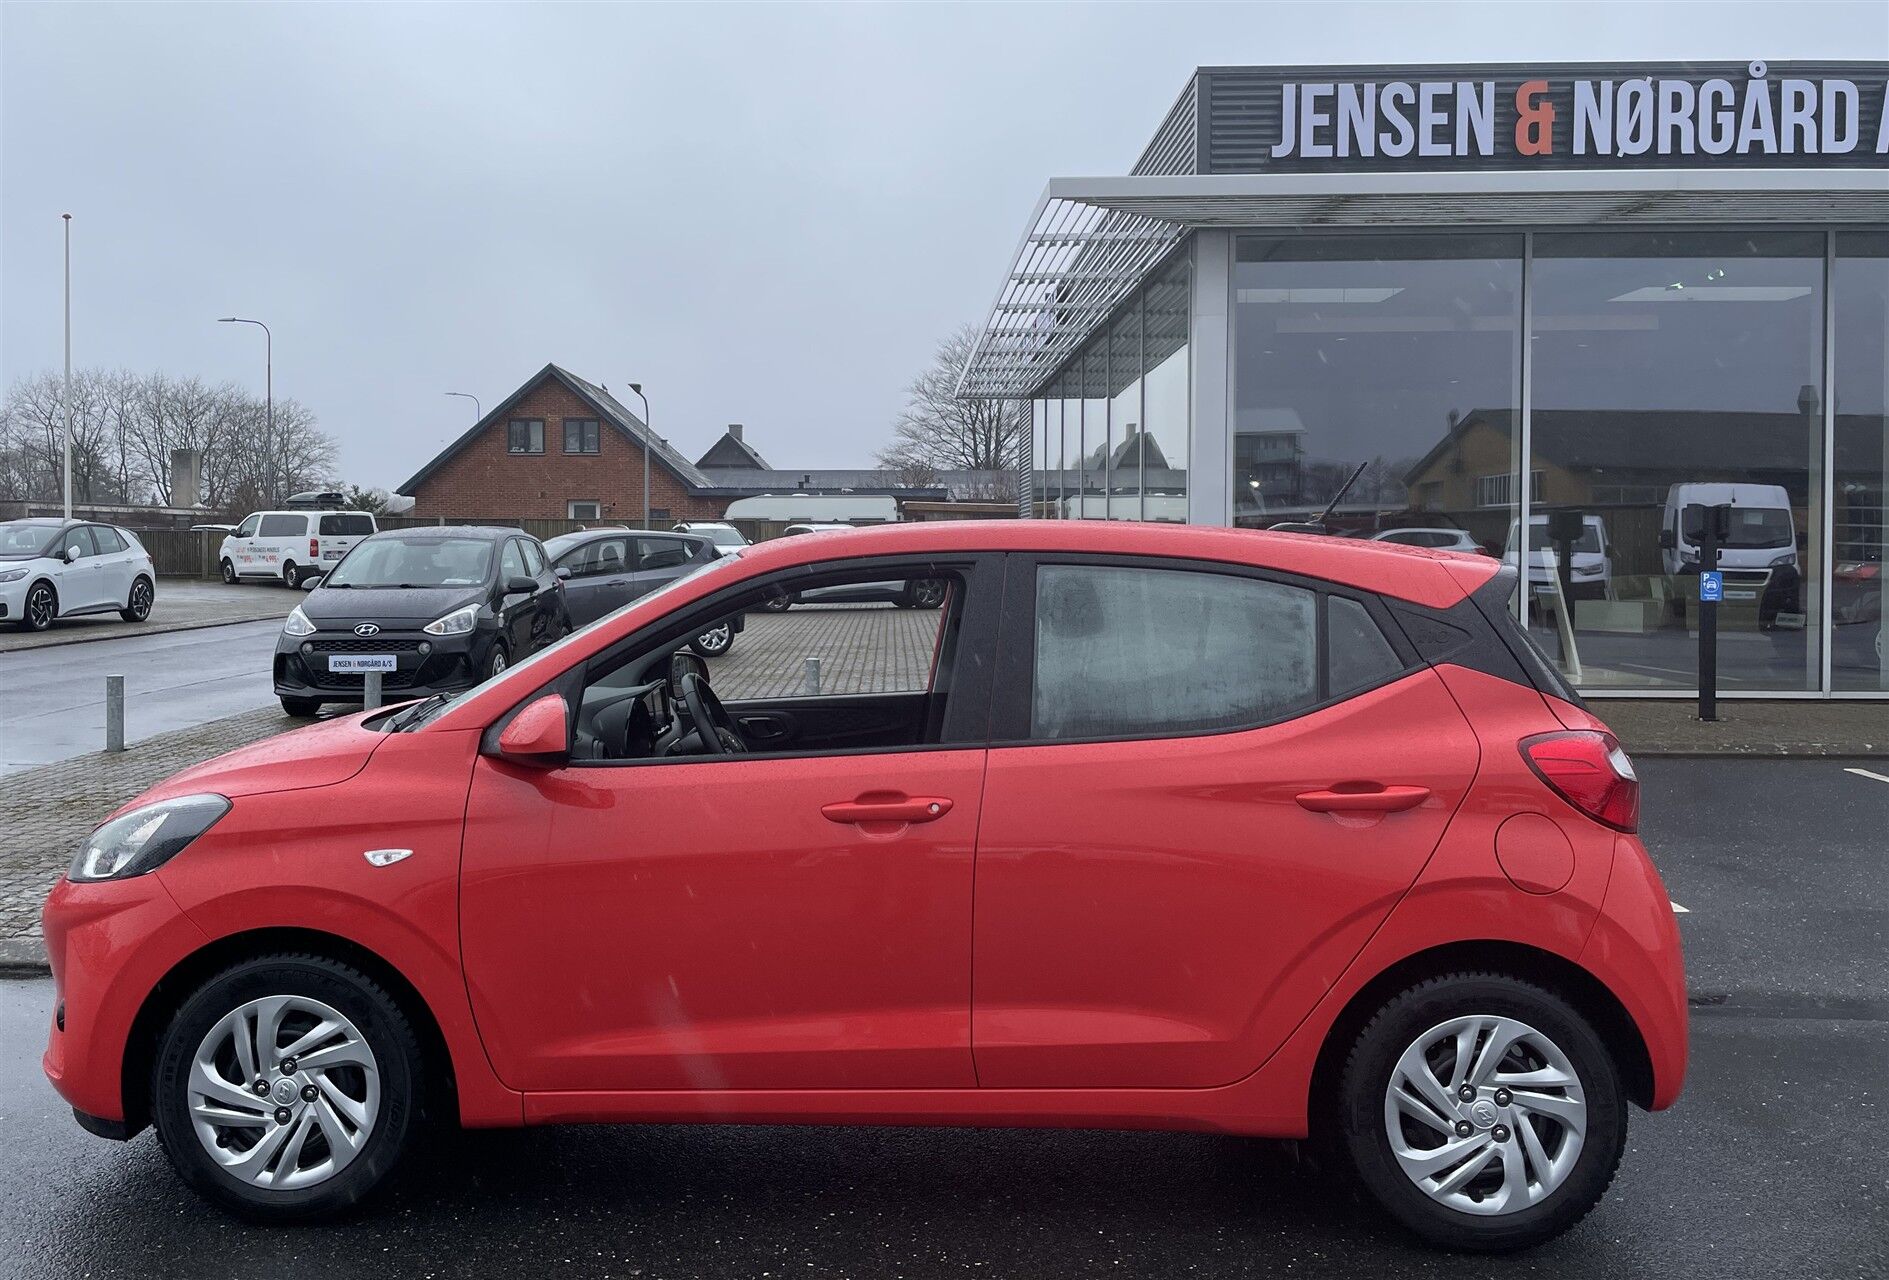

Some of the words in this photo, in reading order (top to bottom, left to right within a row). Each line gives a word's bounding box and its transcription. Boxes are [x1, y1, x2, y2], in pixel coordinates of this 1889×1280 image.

[1271, 81, 1495, 158] JENSEN
[1515, 80, 1556, 156] &
[1573, 59, 1859, 158] NØRGÅRD
[1703, 573, 1710, 582] P
[333, 660, 351, 668] JENSEN
[382, 660, 392, 668] A/S
